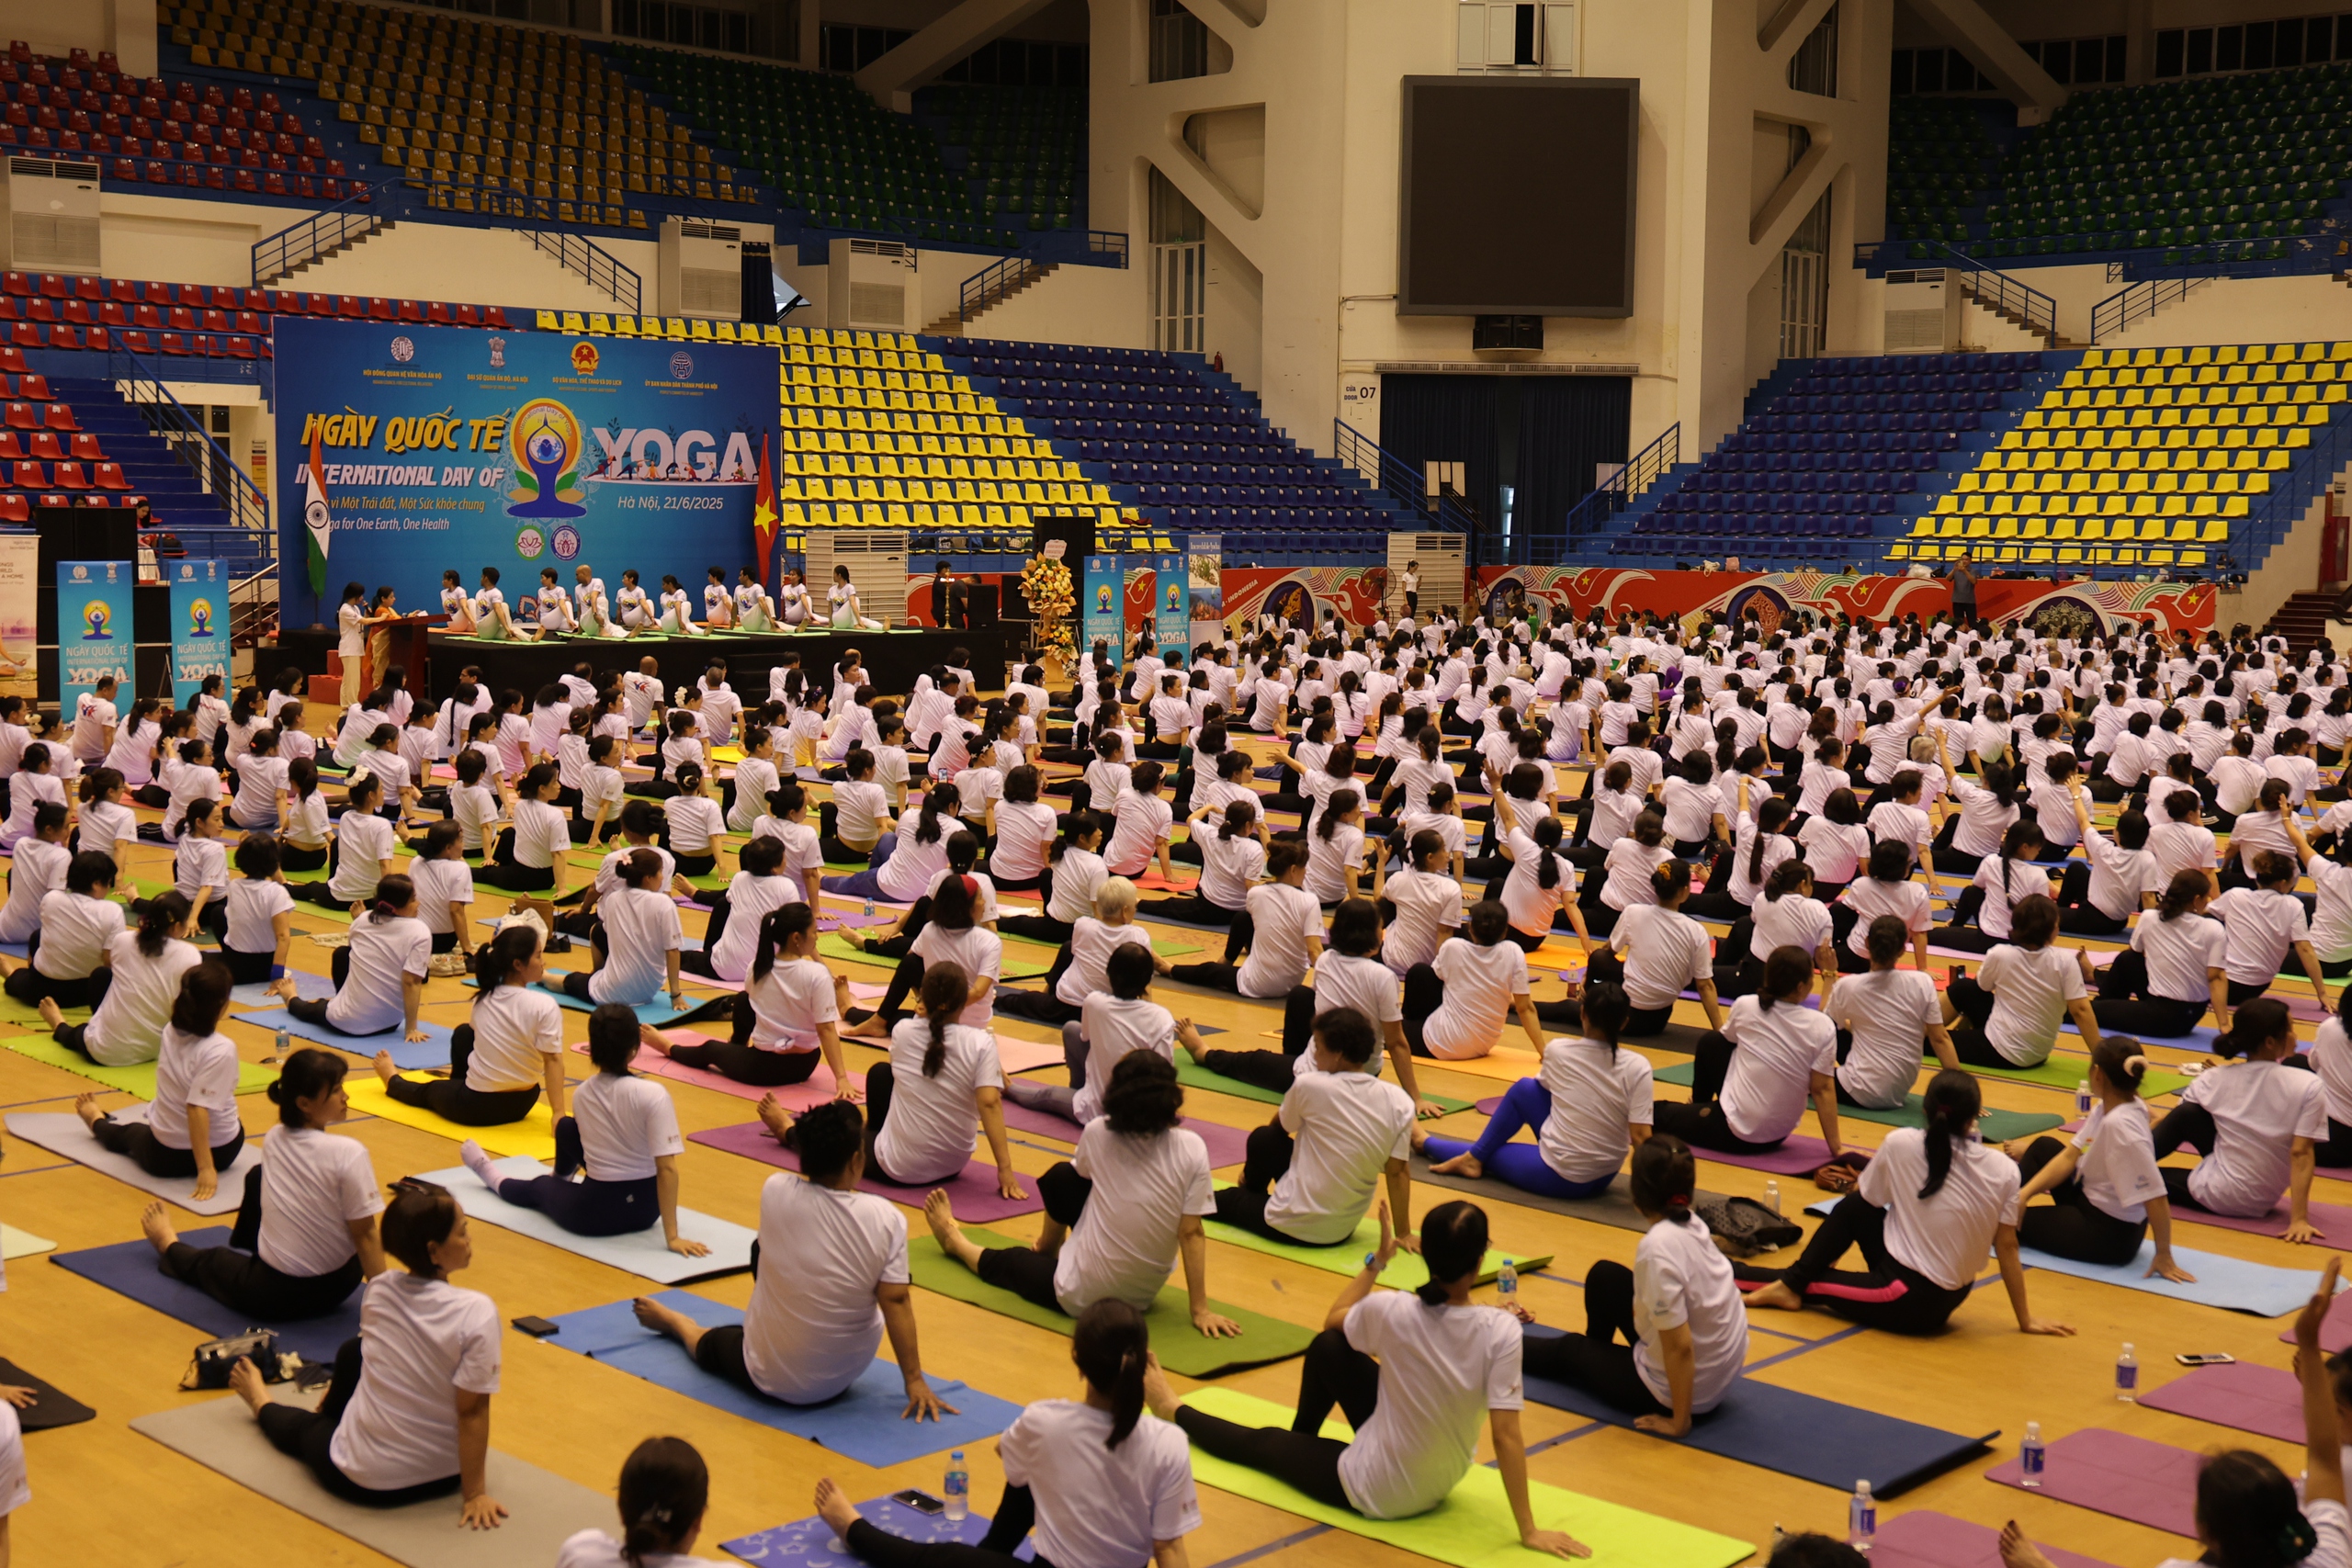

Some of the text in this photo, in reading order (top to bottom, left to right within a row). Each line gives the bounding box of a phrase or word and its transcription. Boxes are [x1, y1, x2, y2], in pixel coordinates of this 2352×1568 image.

[1360, 386, 1376, 399] 07
[546, 406, 558, 416] Day
[300, 405, 511, 453] NGÀY QUỐC TẾ
[591, 427, 758, 480] YOGA
[441, 467, 475, 487] DAY
[479, 468, 504, 487] OF
[331, 497, 339, 508] vì
[341, 496, 360, 512] Một
[362, 496, 377, 509] Trái
[379, 496, 397, 511] đất,
[399, 498, 417, 512] Một
[419, 496, 434, 510] Sức
[458, 499, 485, 513] chung
[618, 496, 724, 511] Hà Nội, 21/6/2025
[342, 517, 355, 530] for
[356, 518, 374, 530] One
[375, 517, 401, 532] Earth,
[403, 519, 419, 531] One
[420, 519, 450, 531] Health
[1227, 579, 1258, 604] INDONESIA
[1088, 633, 1119, 646] YOGA
[1159, 632, 1187, 643] YOGA
[66, 643, 129, 657] NGÀY QUỐC TẾ
[177, 640, 226, 654] NGÀY QUỐC TẾ
[68, 666, 128, 683] YOGA
[179, 663, 226, 681] YOGA
